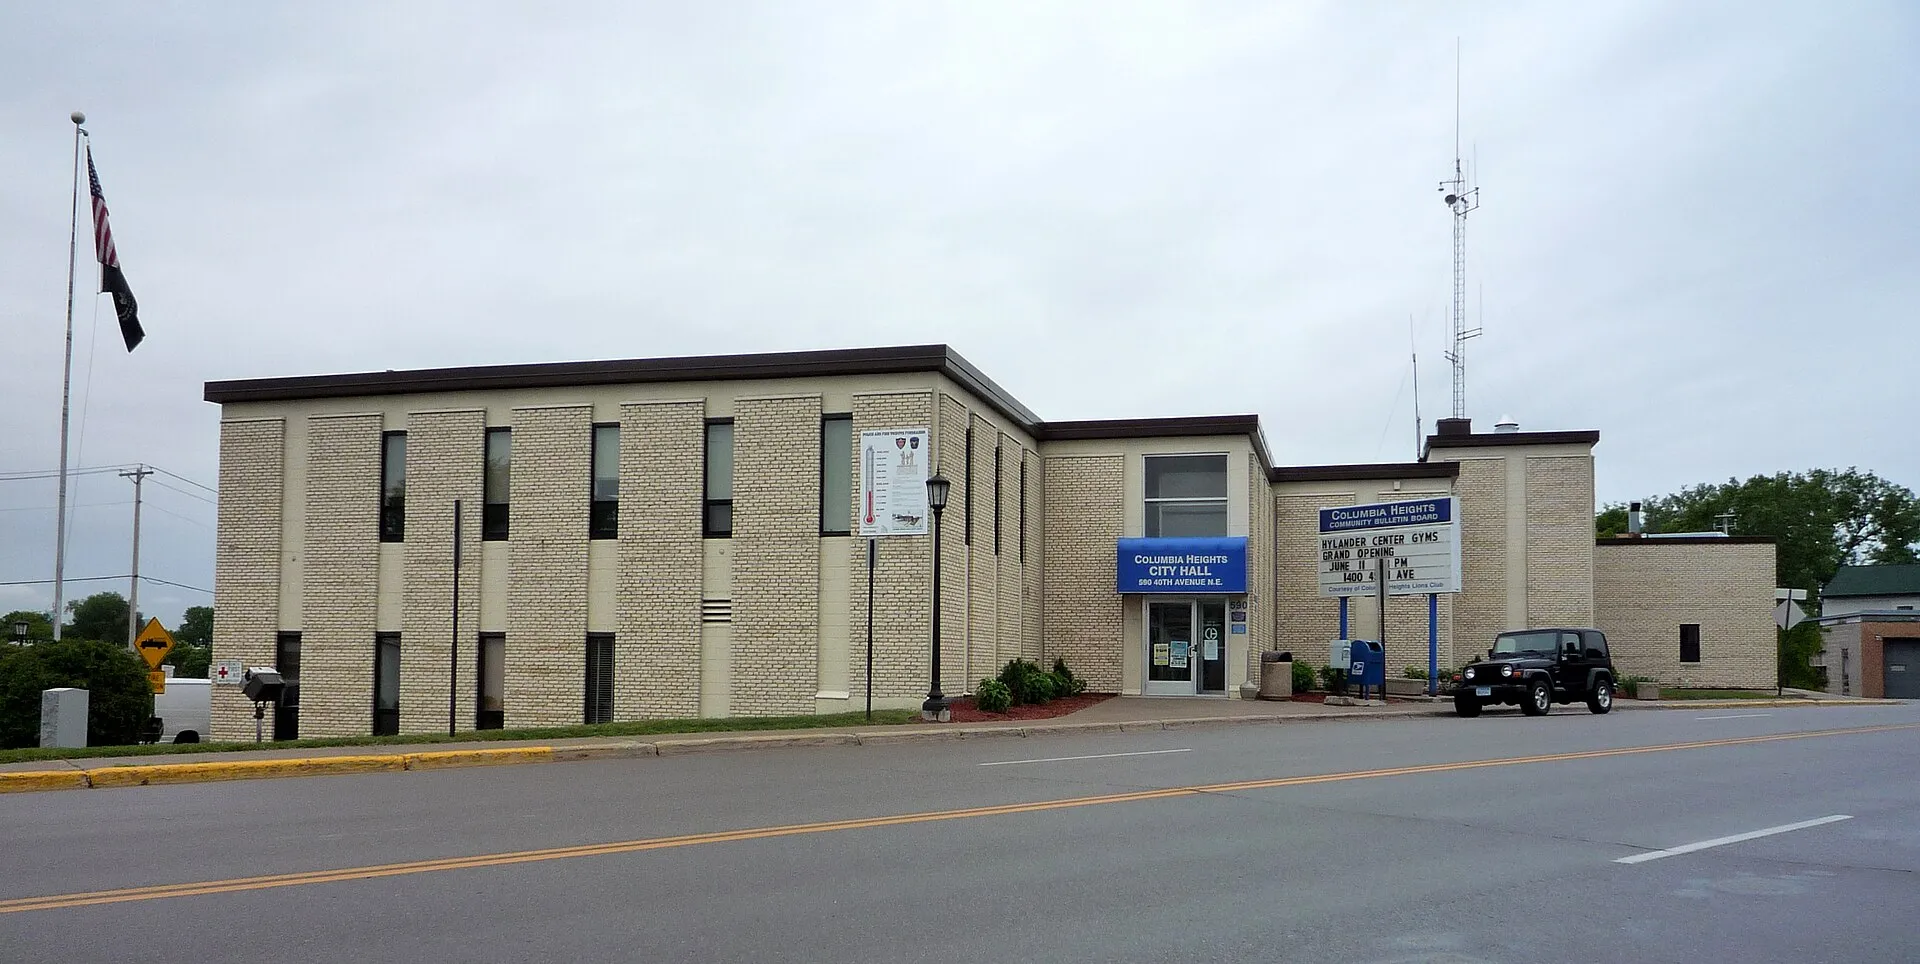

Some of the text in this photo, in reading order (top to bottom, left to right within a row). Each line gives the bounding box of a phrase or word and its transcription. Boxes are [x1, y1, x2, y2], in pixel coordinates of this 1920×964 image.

[1331, 503, 1435, 520] COLUMBIA HEIGHTS
[1329, 513, 1438, 528] COMMUNITY BULLETIN BOARD
[1322, 531, 1438, 549] HYLANDER CENTER GYMS
[1134, 554, 1228, 564] COLUMBIA HEIGHTS
[1322, 547, 1394, 560] GRAND OPENING
[1149, 566, 1212, 576] CITY HALL
[1329, 561, 1349, 571] JUNE
[1358, 560, 1365, 569] 11
[1394, 558, 1408, 567] PM
[1207, 578, 1223, 586] N.E.
[1343, 572, 1363, 582] 1400
[1396, 569, 1415, 579] AVE
[1328, 585, 1352, 593] Courtesy
[1389, 583, 1411, 591] Heights
[1230, 601, 1247, 610] 590
